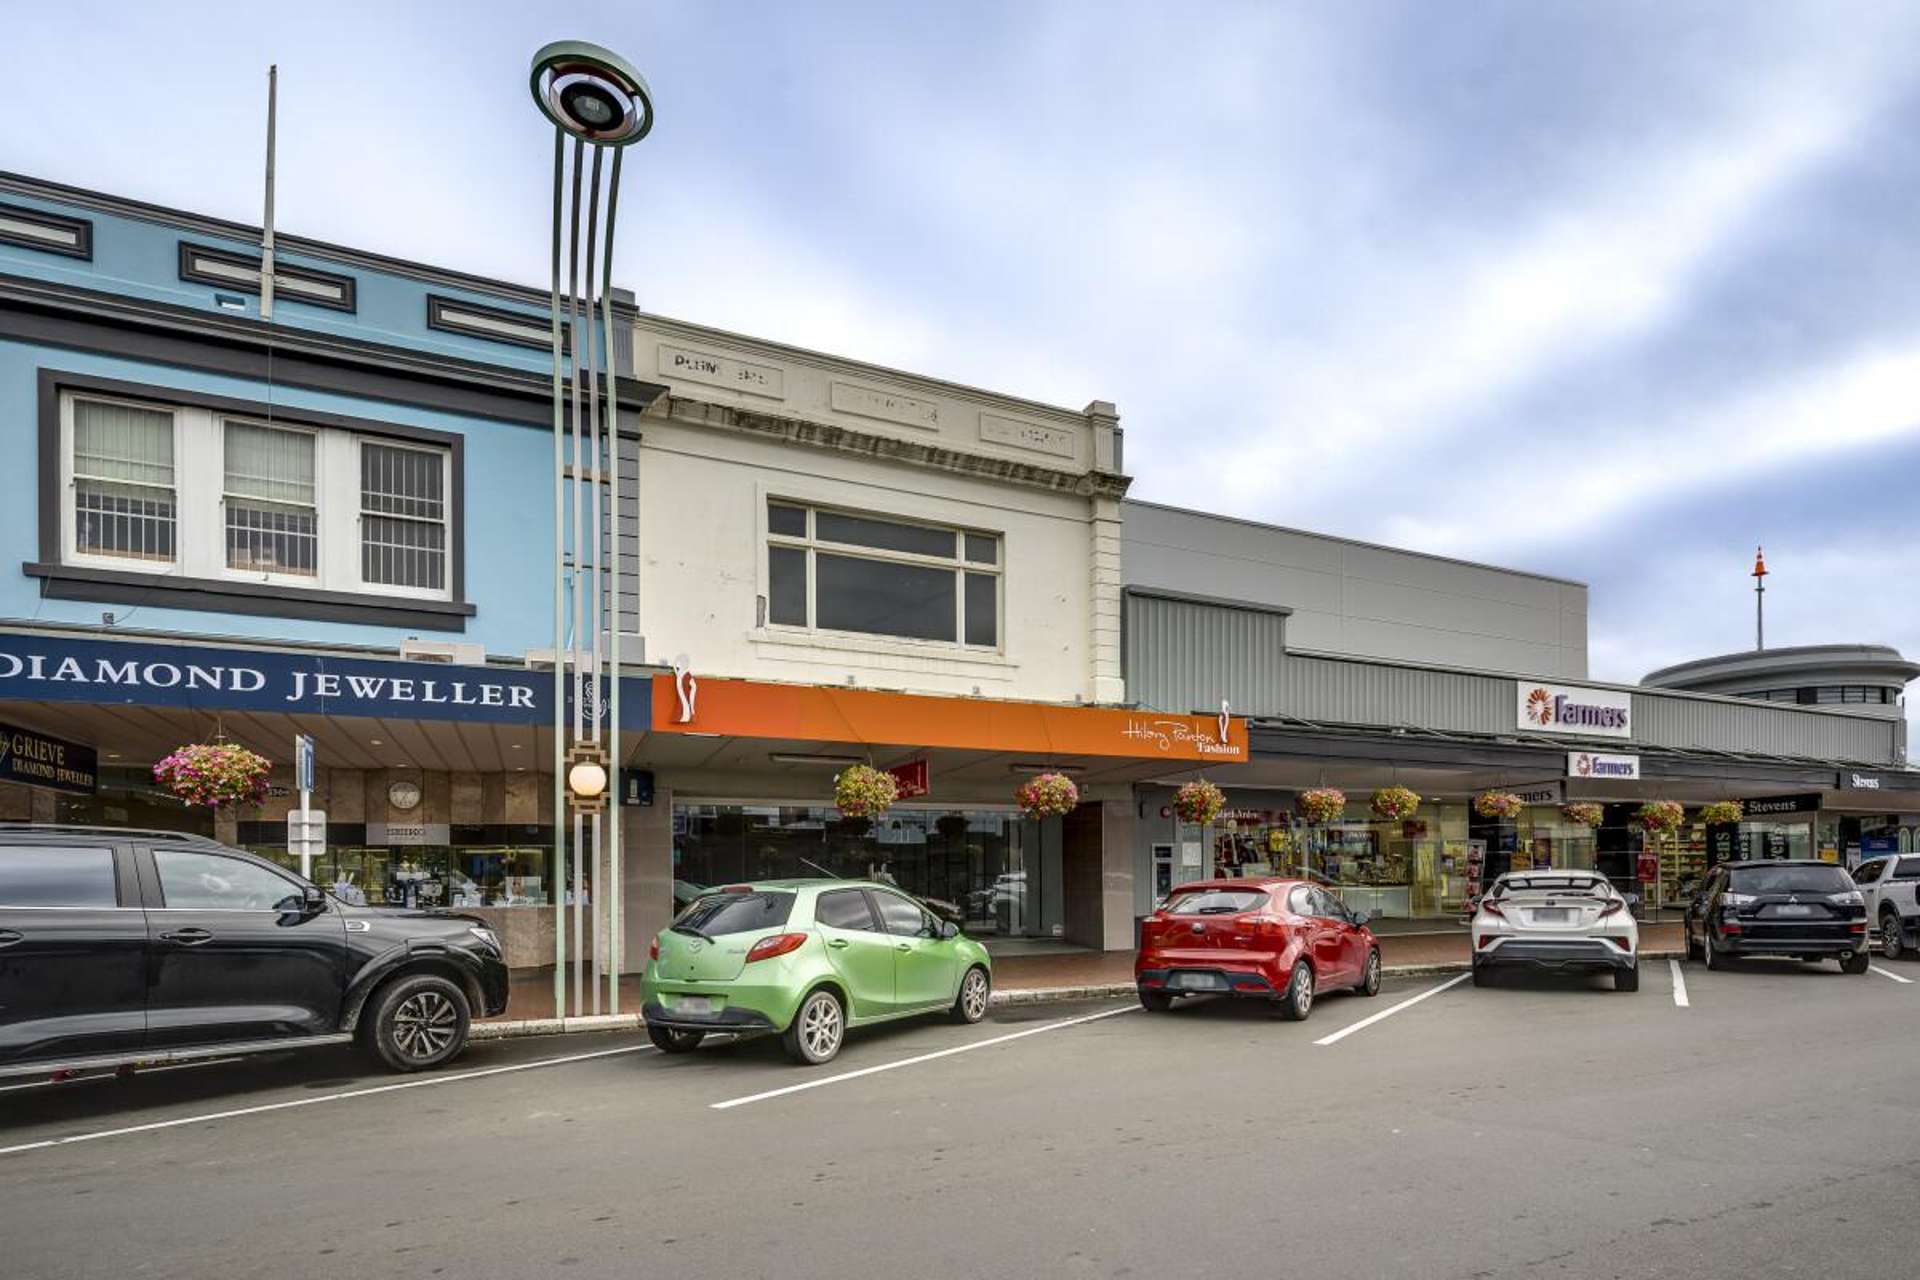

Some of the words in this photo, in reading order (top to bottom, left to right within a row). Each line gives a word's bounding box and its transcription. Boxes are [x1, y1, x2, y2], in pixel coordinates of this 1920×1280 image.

[0, 653, 266, 692] DIAMOND
[286, 672, 536, 708] JEWELLER
[1554, 694, 1627, 729] Farmers
[12, 734, 65, 766] GRIEVE
[1197, 740, 1240, 755] Fashion
[12, 758, 55, 778] DIAMOND
[1851, 774, 1880, 790] Stevens
[1749, 800, 1797, 814] Stevens
